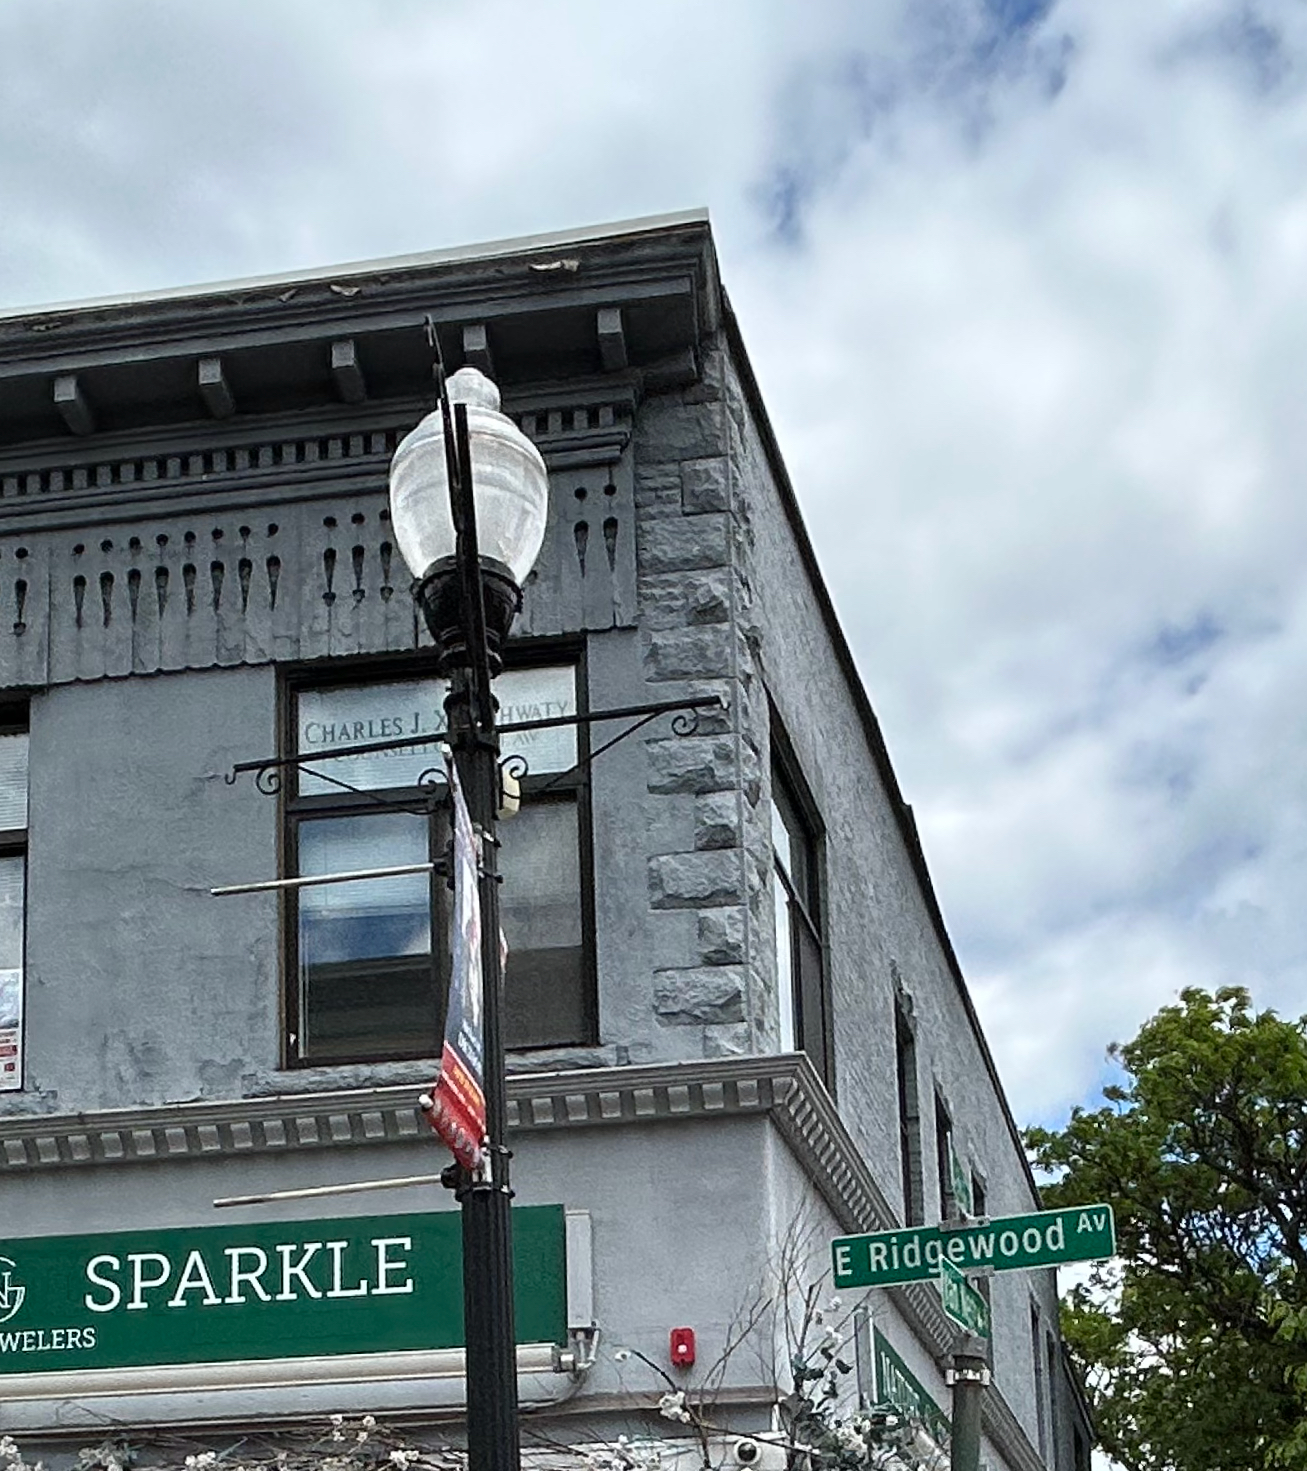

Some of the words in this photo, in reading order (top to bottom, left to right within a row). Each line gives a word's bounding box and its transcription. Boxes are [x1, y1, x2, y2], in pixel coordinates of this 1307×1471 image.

[304, 716, 403, 744] CHARLES
[83, 1235, 415, 1313] SPARKLE
[835, 1245, 853, 1277] E
[868, 1216, 1066, 1274] Ridgewood
[1075, 1211, 1107, 1235] Av
